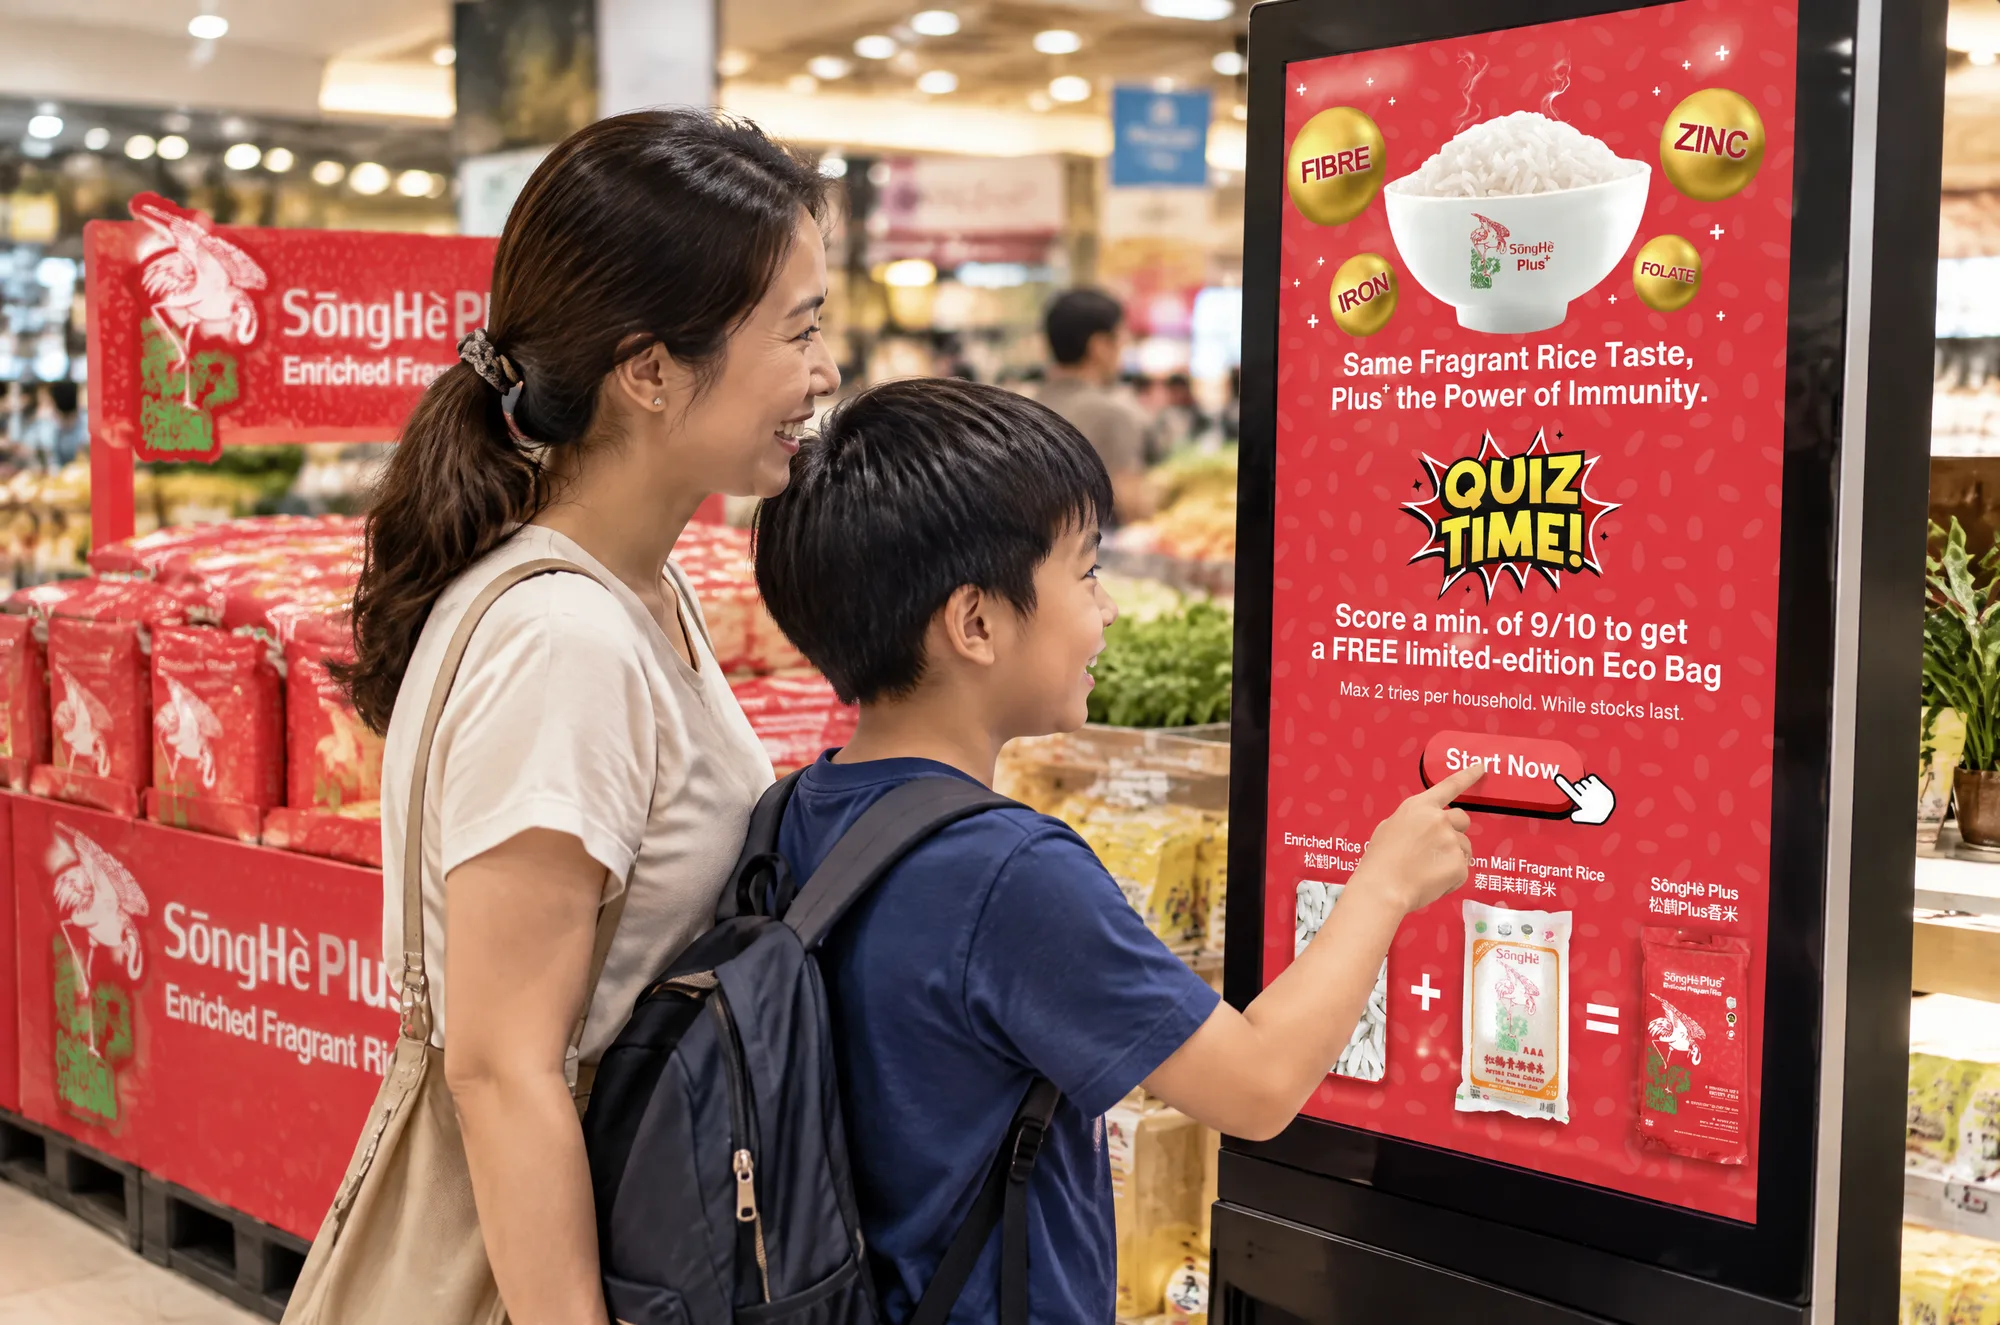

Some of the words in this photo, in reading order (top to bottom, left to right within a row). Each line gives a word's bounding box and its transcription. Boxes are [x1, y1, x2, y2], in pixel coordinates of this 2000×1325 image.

[1674, 122, 1749, 159] ZINC
[1302, 146, 1371, 184] FIBRE
[1641, 261, 1696, 283] FOLATE
[1338, 272, 1389, 313] IRON
[282, 288, 448, 349] SōngHè
[283, 355, 391, 385] Enriched
[1344, 352, 1412, 376] Same
[1421, 348, 1529, 377] Fragrant
[1538, 344, 1596, 369] Rice
[1605, 341, 1692, 370] Taste,
[1396, 386, 1436, 409] the
[1445, 384, 1526, 408] Power
[1534, 381, 1561, 406] of
[1569, 377, 1707, 409] Immunity.
[1445, 454, 1582, 511] QUIZ
[1441, 510, 1582, 569] TIME!
[1336, 603, 1406, 630] Score
[1413, 613, 1427, 631] a
[1436, 609, 1488, 634] min.
[1497, 611, 1523, 636] of
[1531, 612, 1595, 639] 9/10
[1604, 616, 1632, 641] to
[1641, 620, 1688, 649] get
[1312, 642, 1324, 659] a
[1333, 637, 1397, 663] FREE
[1406, 641, 1593, 676] limited-edition
[1604, 651, 1656, 680] Eco
[1666, 655, 1720, 691] Bag
[1341, 681, 1369, 697] Max
[1375, 684, 1383, 698] 2
[1388, 685, 1419, 701] tries
[1424, 691, 1448, 705] per
[1453, 690, 1536, 710] household.
[1542, 695, 1585, 713] While
[1591, 700, 1644, 718] stocks
[1650, 703, 1683, 720] last.
[1446, 748, 1501, 775] Start
[1507, 754, 1560, 780] Now
[1285, 832, 1332, 849] Enriched
[1336, 838, 1361, 853] Rice
[1467, 857, 1488, 869] om
[1519, 859, 1572, 878] Fragrant
[1576, 866, 1605, 881] Rice
[1709, 883, 1738, 900] Plus
[165, 901, 310, 990] SōngHè
[166, 984, 257, 1041] Enriched
[263, 1010, 357, 1065] Fragrant
